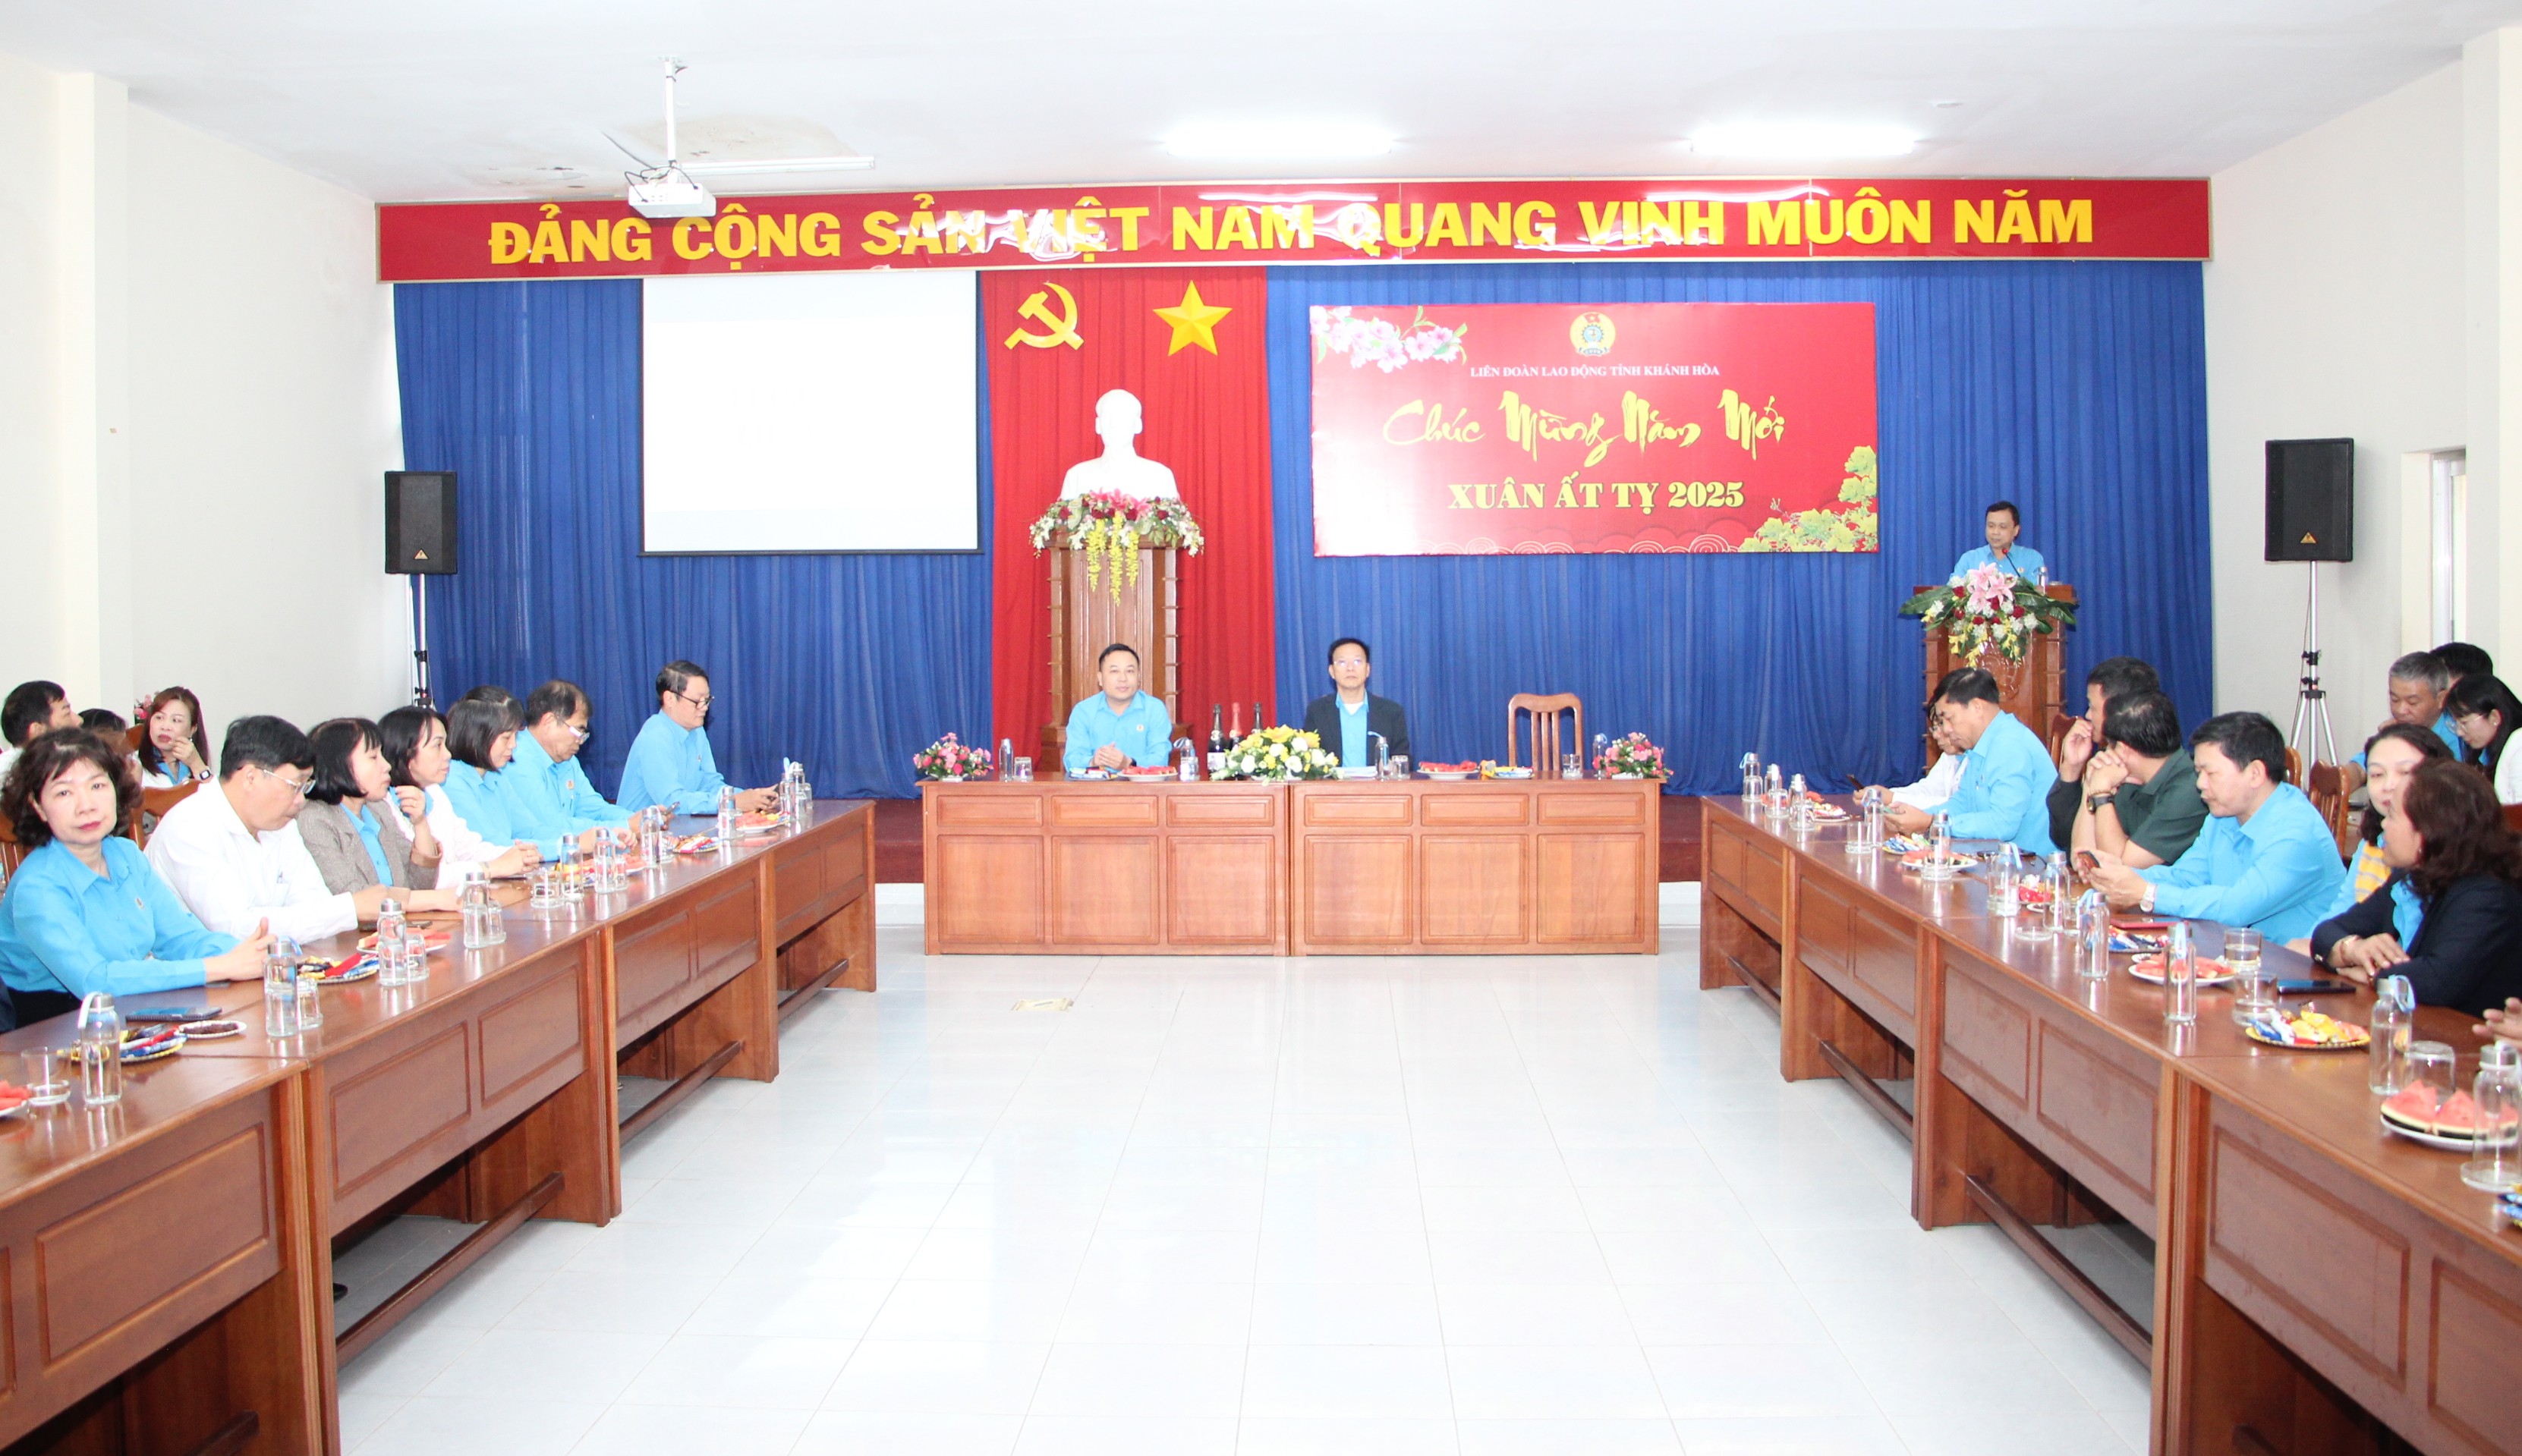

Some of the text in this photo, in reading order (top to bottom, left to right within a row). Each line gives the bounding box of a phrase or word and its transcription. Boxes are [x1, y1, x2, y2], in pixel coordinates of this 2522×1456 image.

[488, 187, 2092, 270] ĐẢNG CỘNG SẢN VIỆT NAM QUANG VINH MUÔN NĂM
[1470, 364, 1500, 377] LIÊN
[1503, 364, 1539, 376] ĐOÀN
[1541, 366, 1568, 376] LAO
[1570, 364, 1607, 379] ĐỘNG
[1644, 363, 1689, 376] KHÁNH
[1692, 363, 1720, 376] HÒA
[1382, 399, 1487, 445] Chúc
[1621, 390, 1702, 456] Năm
[1447, 476, 1545, 509] XUÂN
[1554, 471, 1603, 508] ẤT
[1668, 480, 1745, 508] 2025
